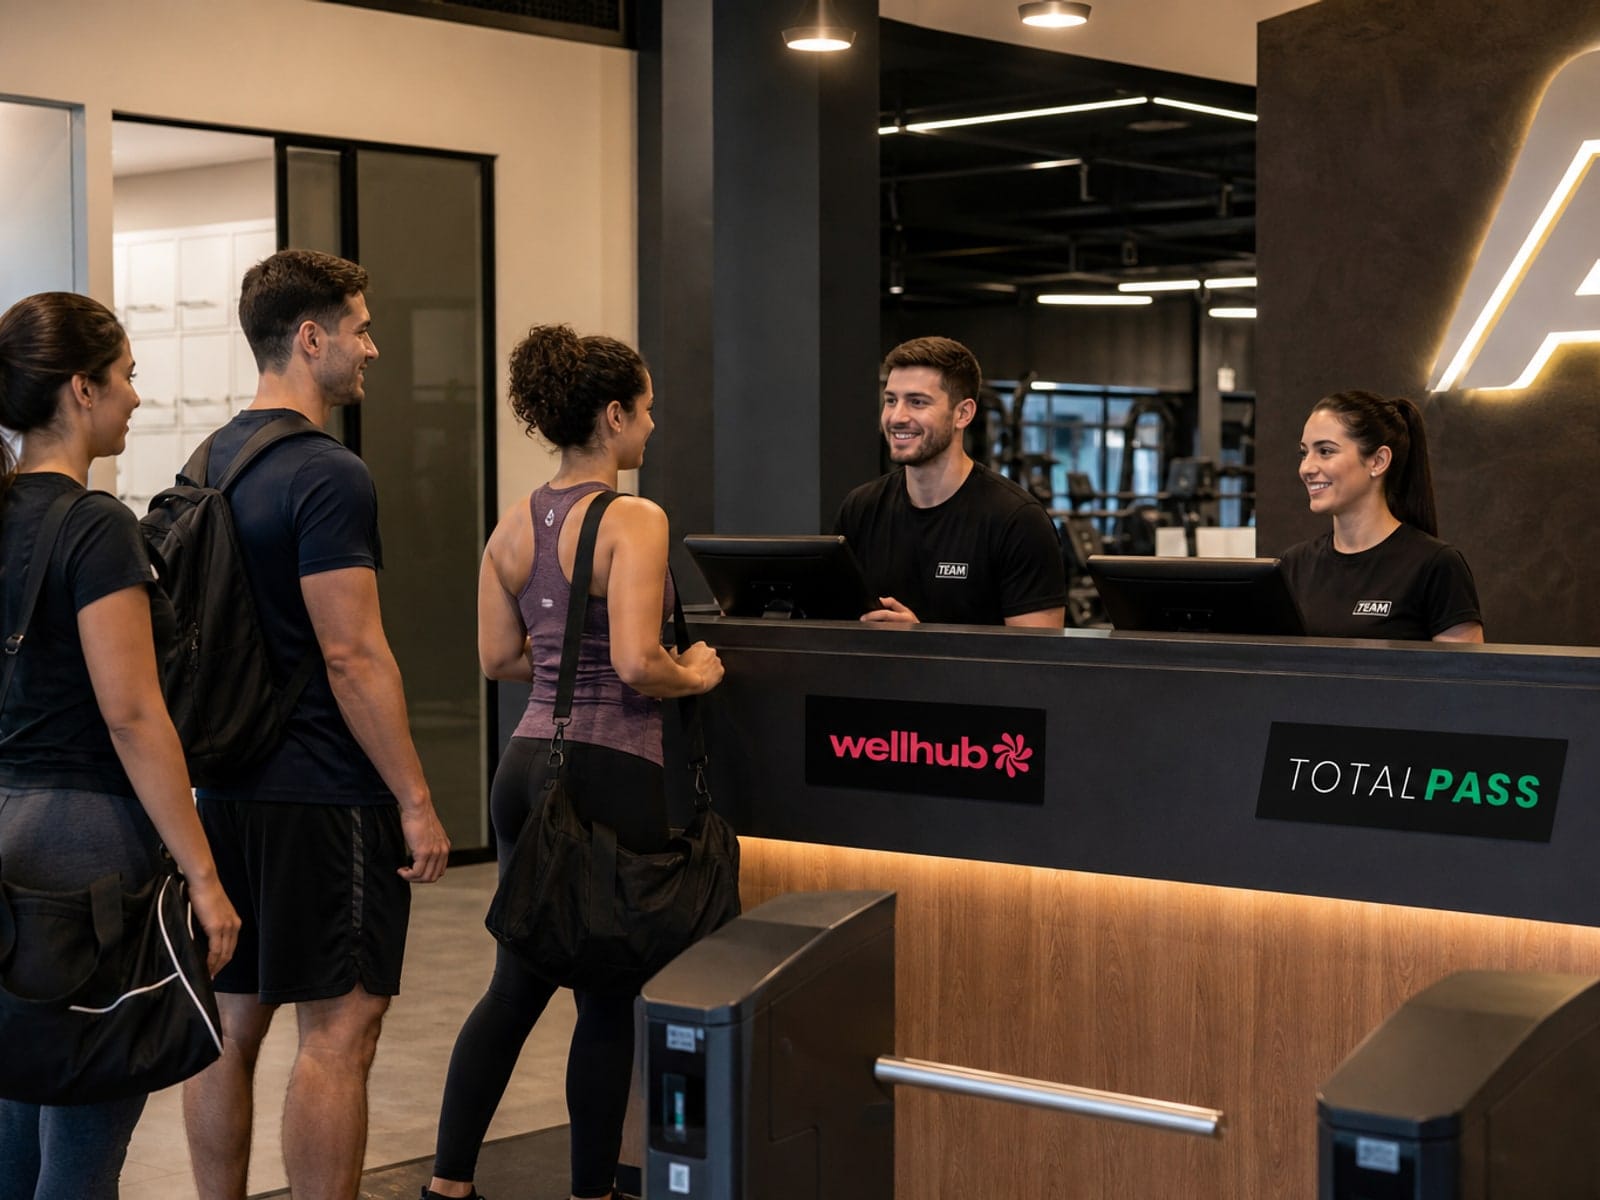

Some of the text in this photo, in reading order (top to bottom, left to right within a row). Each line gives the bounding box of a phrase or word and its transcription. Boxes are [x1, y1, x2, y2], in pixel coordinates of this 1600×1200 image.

[938, 564, 966, 576] TEAM
[1357, 602, 1389, 613] TEAM
[829, 730, 989, 770] wellhub
